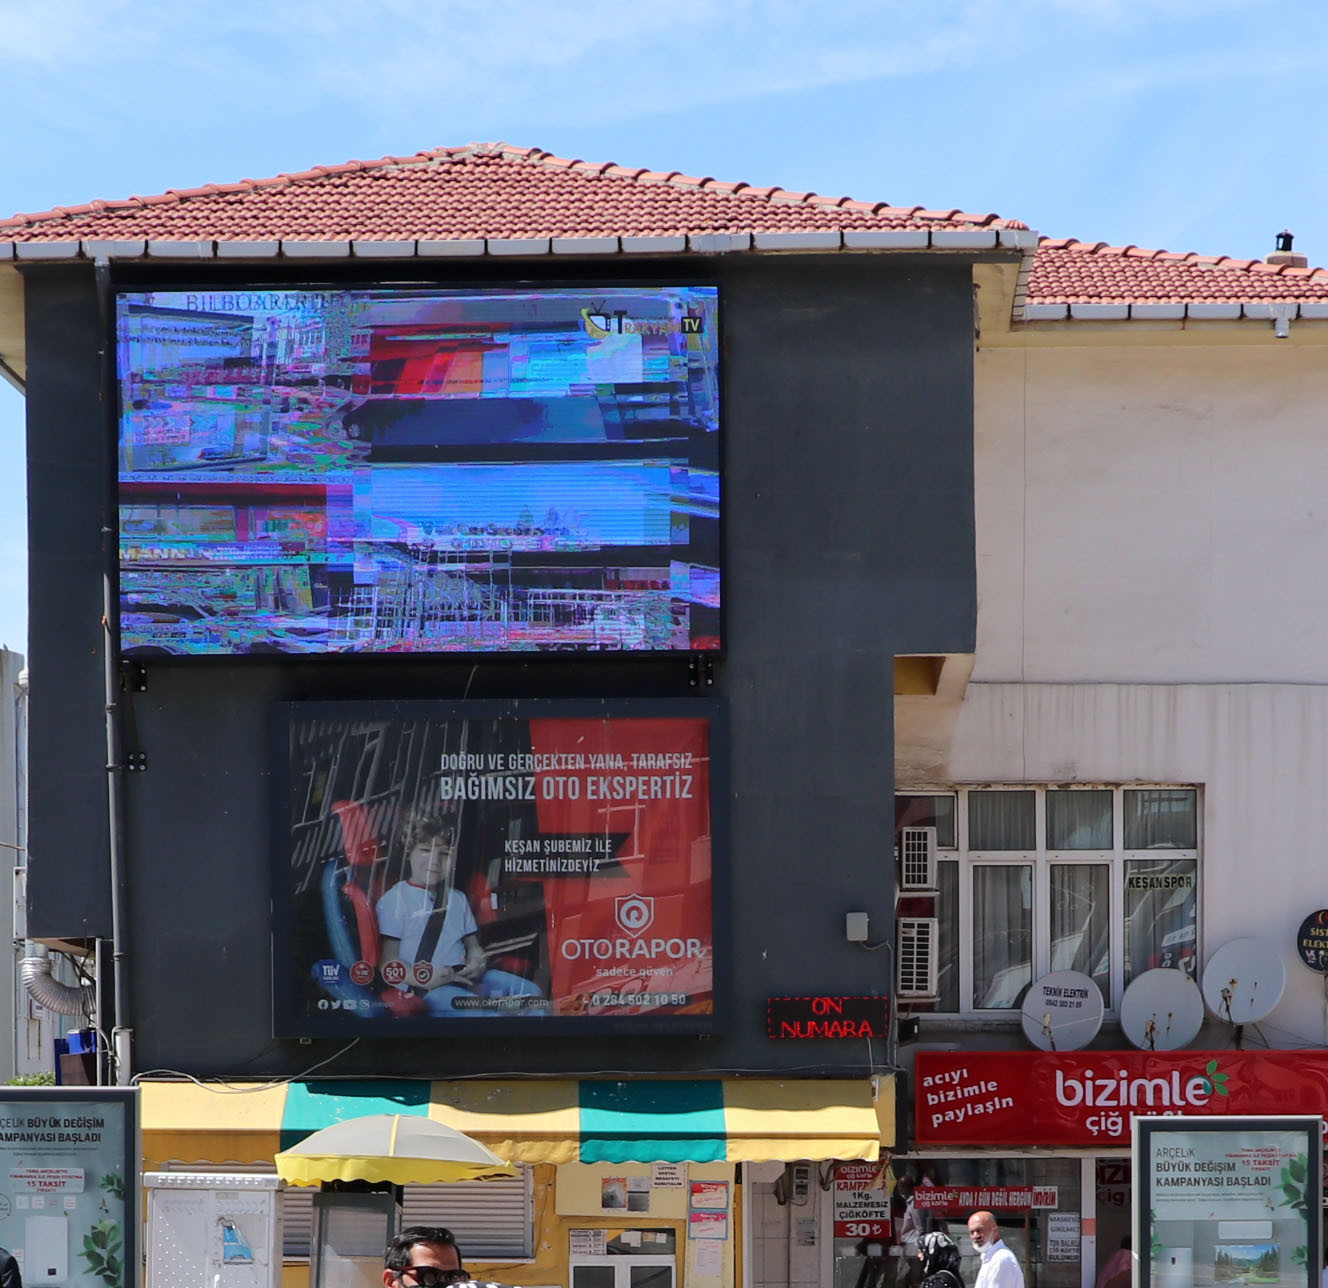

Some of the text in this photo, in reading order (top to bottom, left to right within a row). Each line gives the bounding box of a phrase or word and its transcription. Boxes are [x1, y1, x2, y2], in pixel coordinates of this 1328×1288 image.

[683, 317, 701, 333] TV
[440, 752, 693, 773] DOĞRU VE GERÇEKTEN YANA, TARAFSIZ
[440, 771, 693, 800] BAĞIMSIZ OTO EKSPERTİZ
[504, 837, 613, 855] KEŞAN ŞUBEMİZ İLE
[504, 857, 601, 873] HİZMETİNİZDEYİZ
[561, 938, 706, 960] OTORAPOR
[627, 994, 650, 1006] 502
[654, 994, 668, 1006] 10
[781, 1019, 874, 1038] NUMARA
[922, 1068, 969, 1088] acıyı
[927, 1080, 999, 1106] bizimle
[1056, 1069, 1211, 1107] bizimle
[27, 1117, 61, 1128] BÜYÜK
[1085, 1113, 1123, 1137] çiğ
[58, 1133, 101, 1145] BAŞLADI
[1156, 1161, 1191, 1172] BÜYÜK
[1253, 1158, 1280, 1166] TAKSİT
[1156, 1176, 1271, 1189] KAMPANYASI BAŞLADI
[915, 1190, 954, 1201] bizimle
[839, 1209, 886, 1220] ÇİĞKÖFTE
